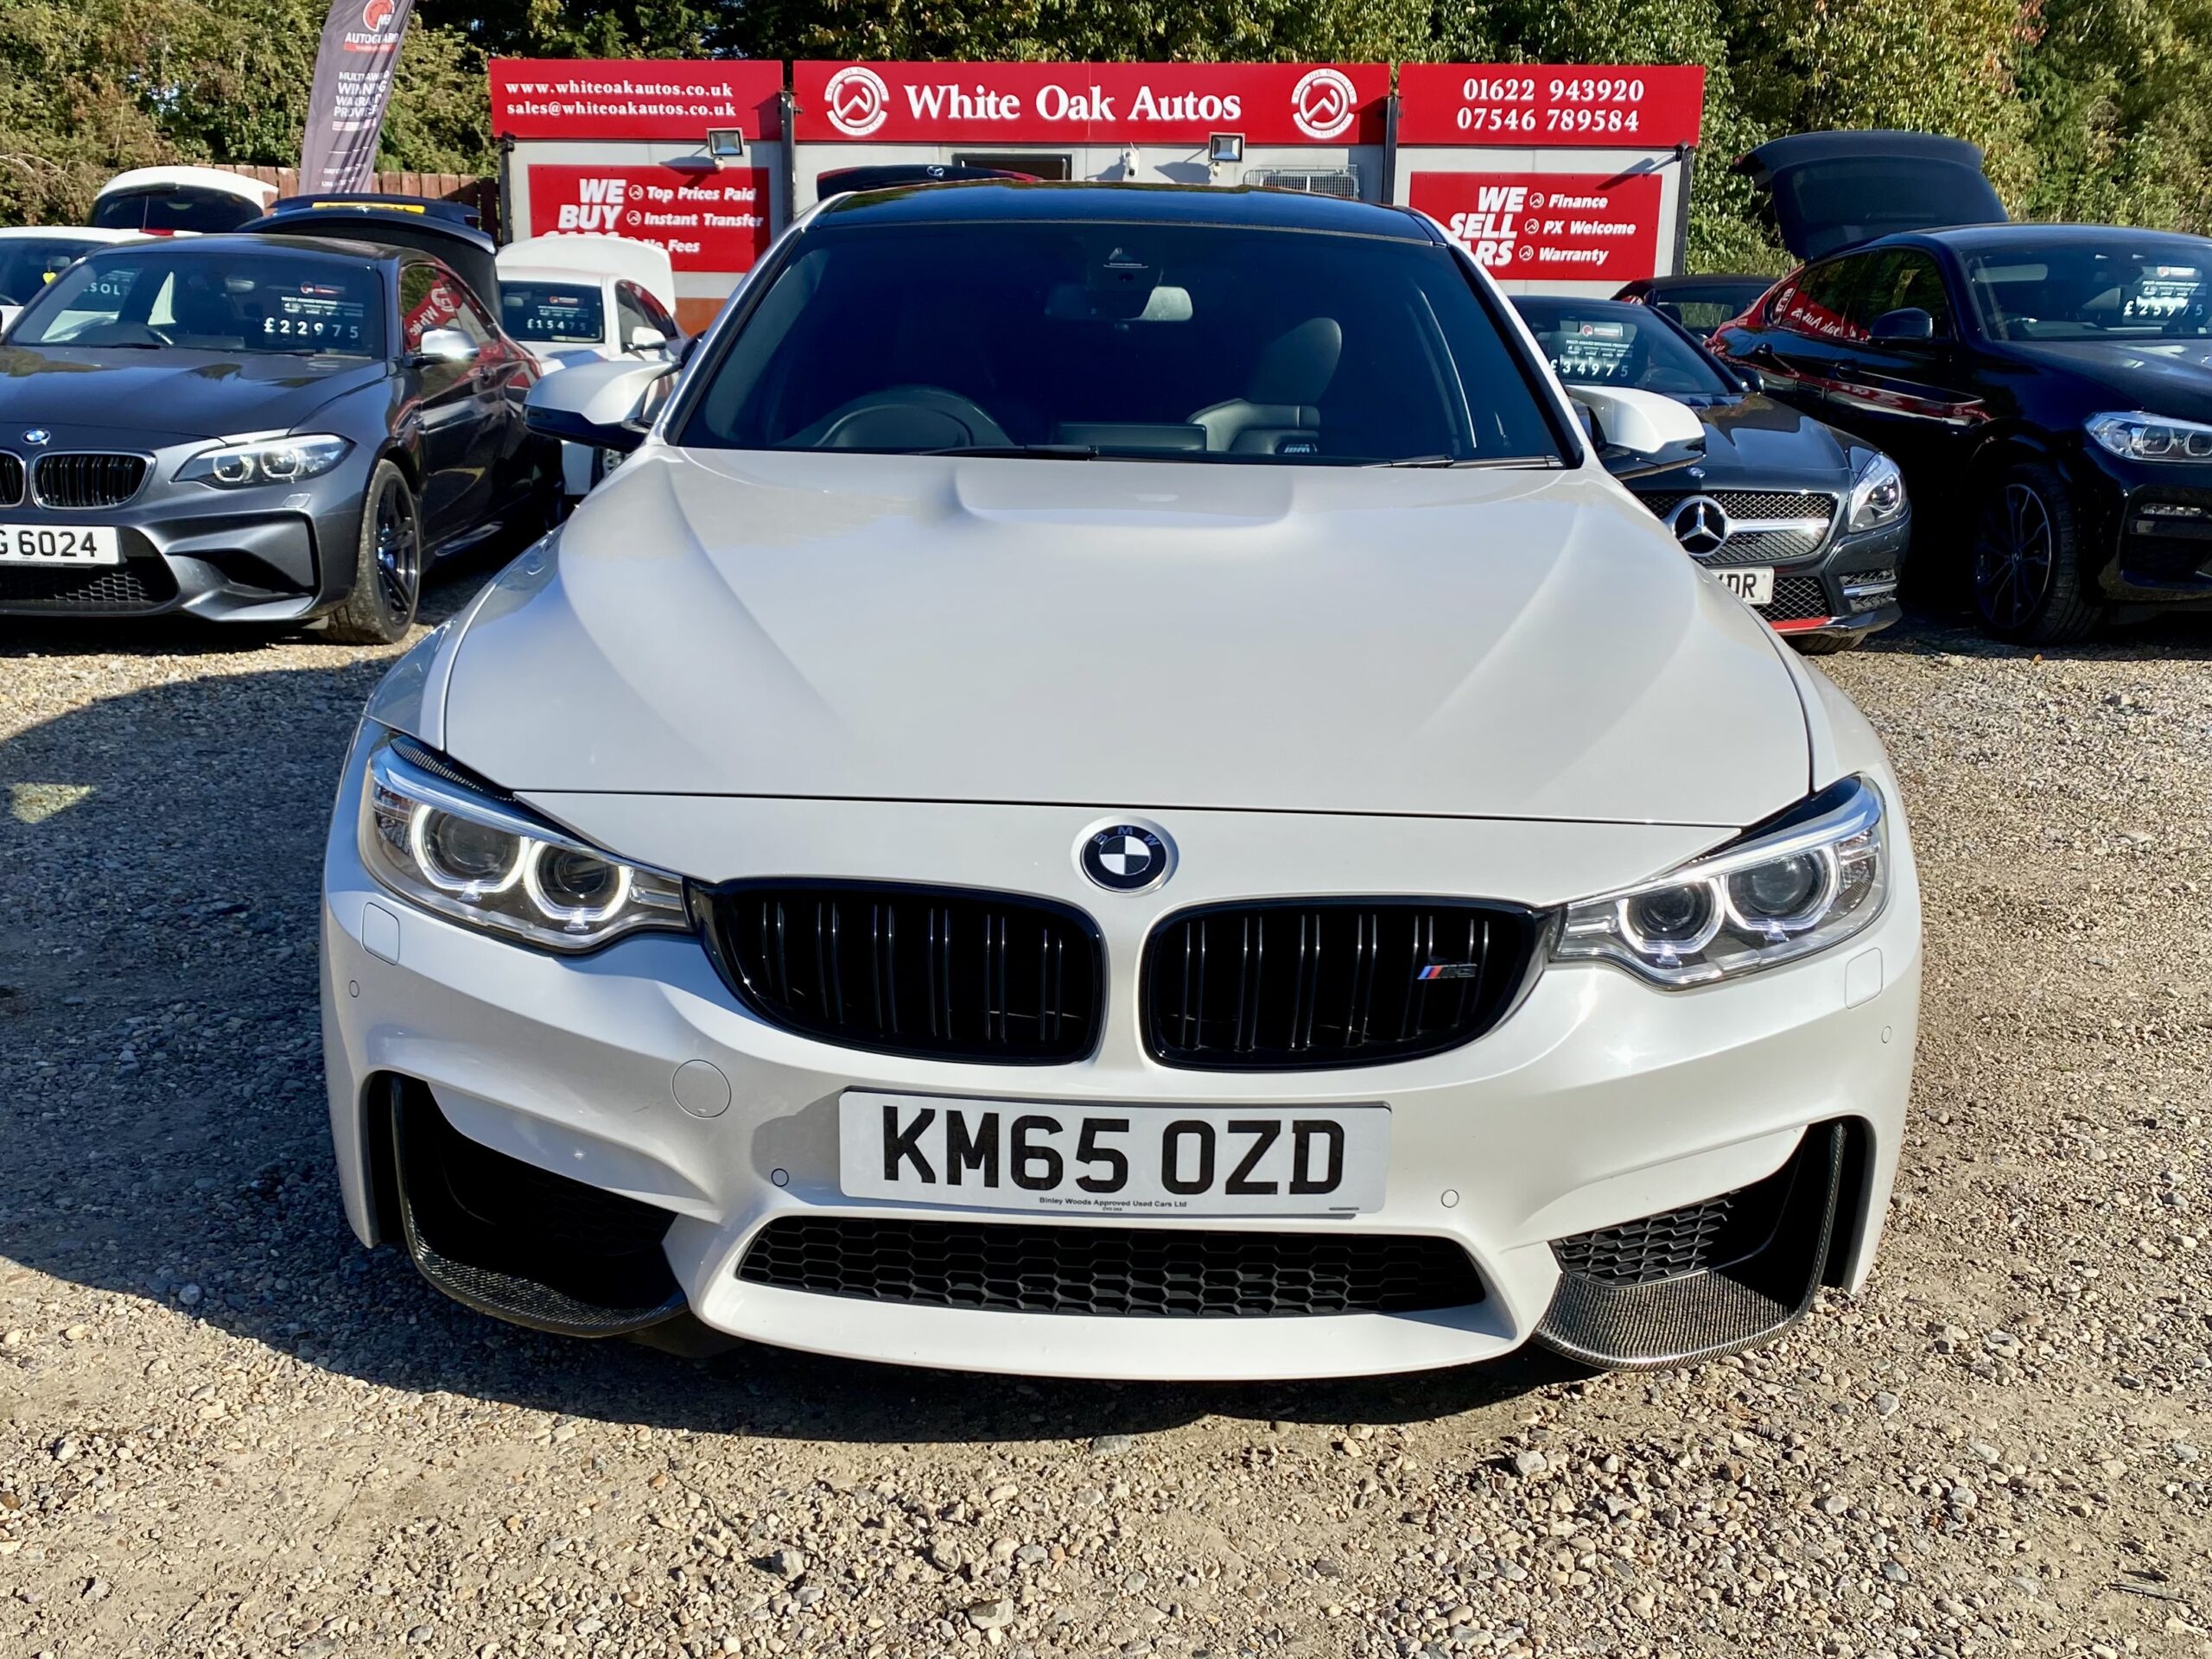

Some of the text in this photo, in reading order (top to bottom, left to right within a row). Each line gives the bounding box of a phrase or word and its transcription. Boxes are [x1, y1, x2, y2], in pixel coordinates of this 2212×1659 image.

[505, 80, 733, 97] www.whiteoakautos.co.uk
[1463, 79, 1644, 102] 01622 943920
[506, 101, 736, 117] sales@whiteoakautos.co.uk
[904, 84, 1242, 121] White Oak Autos
[1457, 107, 1639, 131] 07546 789584
[579, 179, 626, 203] WE
[646, 187, 756, 202] Top Prices Paid
[1478, 187, 1528, 213] WE
[1548, 194, 1608, 208] Finance
[558, 205, 622, 229] BUY
[645, 213, 764, 226] Instant Transfer
[1449, 213, 1518, 238] SELL
[1542, 220, 1637, 234] PX Welcome
[668, 239, 700, 252] Fees
[1466, 241, 1516, 266] ARS
[1539, 247, 1609, 264] Warranty
[264, 317, 359, 339] £22975
[527, 318, 587, 331] £15475
[1550, 359, 1629, 378] £34975
[17, 530, 97, 557] 6024
[1718, 573, 1757, 598] DR
[1093, 826, 1160, 847] BMW
[883, 1105, 1345, 1196] KM65 OZD
[1039, 1197, 1063, 1205] Binley
